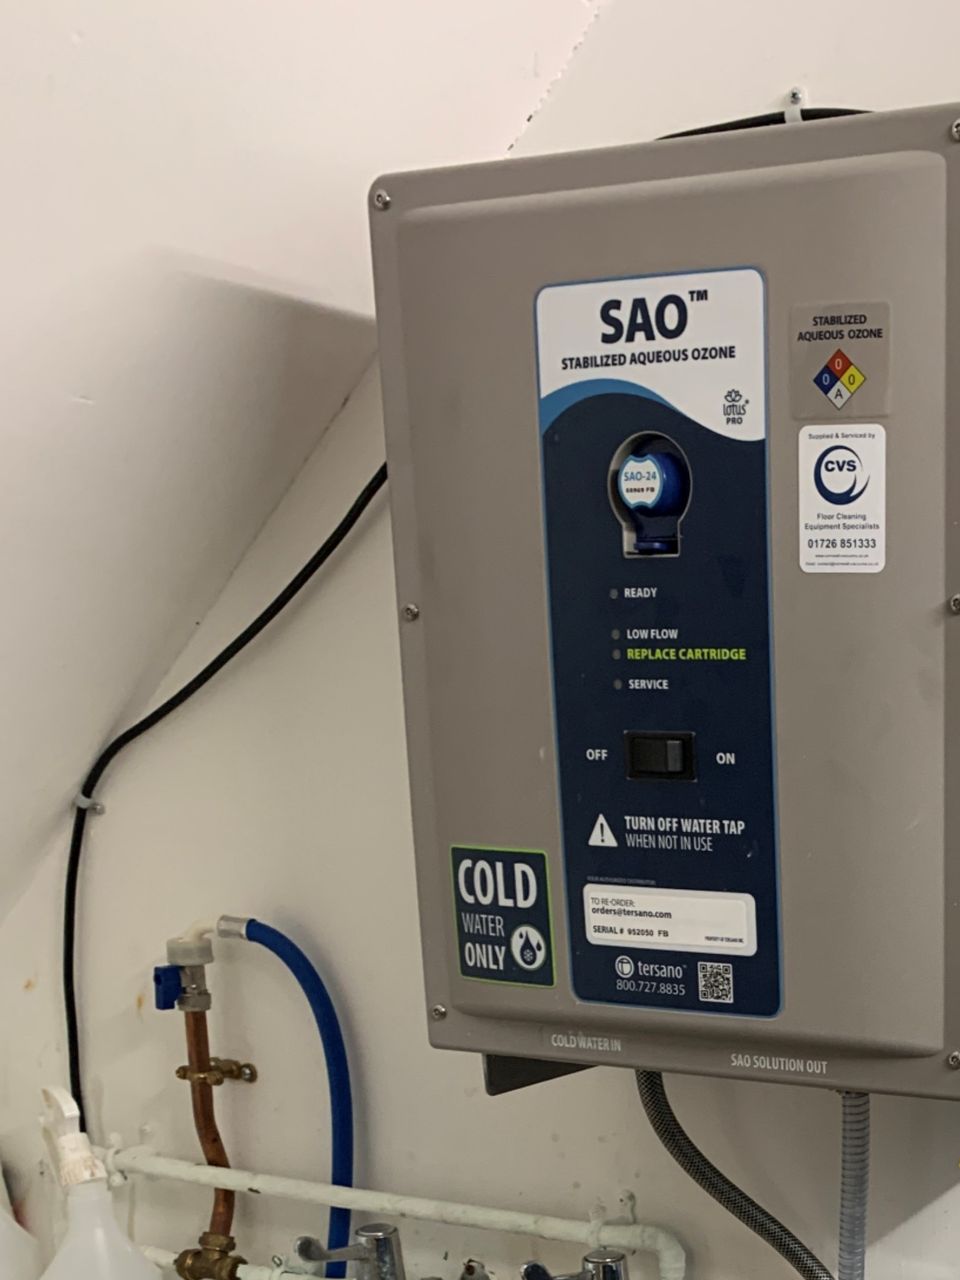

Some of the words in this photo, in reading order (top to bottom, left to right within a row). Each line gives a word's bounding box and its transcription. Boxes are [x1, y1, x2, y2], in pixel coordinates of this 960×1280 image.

[812, 314, 867, 326] STABILIZED
[797, 330, 844, 342] AQUEOUS
[848, 328, 883, 339] OZONE
[561, 353, 627, 370] STABILIZED
[629, 348, 689, 366] AQUEOUS
[691, 345, 736, 361] OZONE
[835, 359, 842, 370] 0
[822, 373, 830, 385] 0
[848, 374, 855, 385] 0
[834, 388, 843, 399] A
[726, 417, 743, 425] PRO
[824, 460, 857, 472] CVS
[836, 513, 866, 521] Cleaning
[804, 523, 841, 531] Equipment
[842, 523, 880, 531] Specialists
[807, 539, 838, 549] 01726
[840, 539, 876, 549] 851333
[624, 587, 658, 598] READY
[626, 629, 648, 640] LOW
[650, 629, 678, 640] FLOW
[626, 648, 676, 660] REPLACE
[678, 648, 747, 660] CARTRIDGE
[628, 679, 669, 690] SERVICE
[586, 748, 608, 761] OFF
[716, 752, 736, 765] ON
[624, 815, 656, 832] TURN
[657, 817, 679, 832] OFF
[681, 818, 720, 835] WATER
[722, 820, 745, 836] TAP
[625, 833, 656, 849] WHEN
[658, 835, 679, 850] NOT
[680, 836, 692, 850] IN
[694, 836, 713, 852] USE
[458, 858, 537, 909] COLD
[591, 897, 600, 906] TO
[591, 906, 672, 919] orders@tersano.com
[461, 912, 505, 938] WATER
[593, 925, 618, 935] SERIAL
[657, 930, 669, 938] FB
[465, 942, 506, 971] ONLY
[616, 979, 686, 996] 800.727.8835
[551, 1033, 577, 1047] COLD
[577, 1036, 610, 1050] WATER
[610, 1039, 621, 1052] IN
[730, 1053, 750, 1068] SAO
[753, 1055, 804, 1072] SOLUTION
[806, 1060, 828, 1075] OUT
